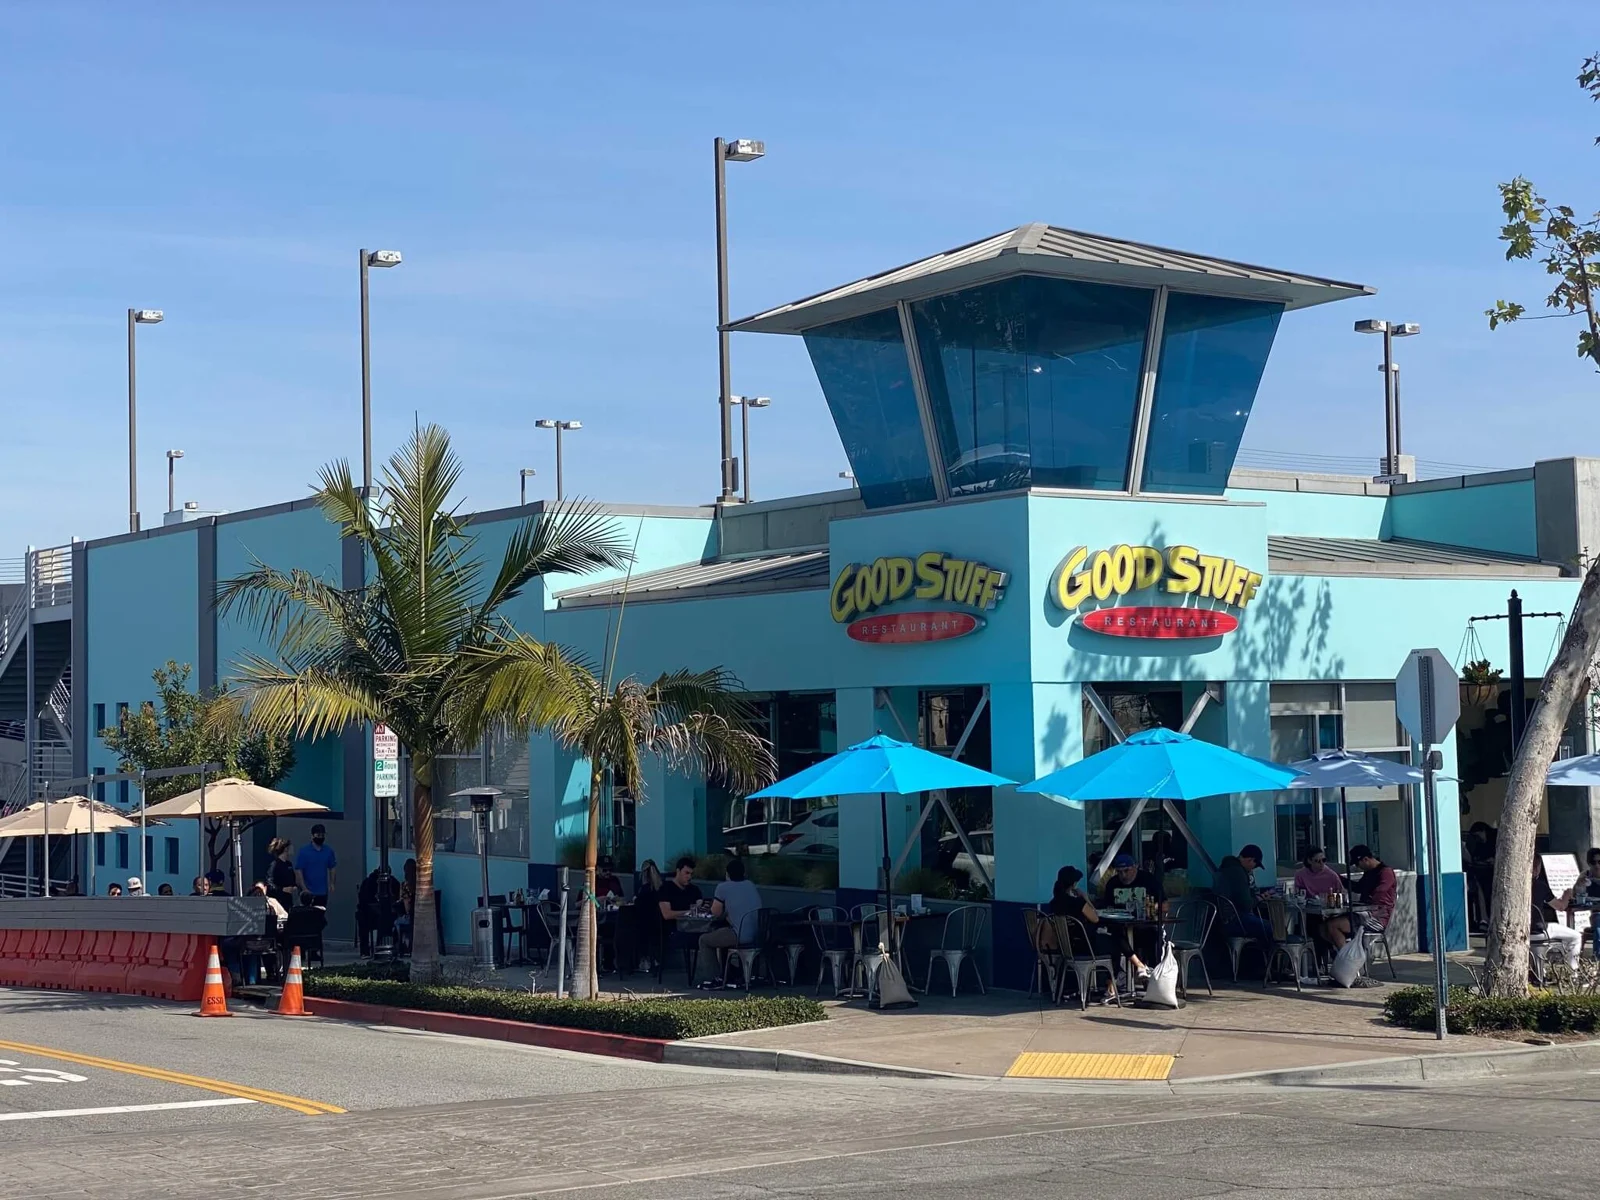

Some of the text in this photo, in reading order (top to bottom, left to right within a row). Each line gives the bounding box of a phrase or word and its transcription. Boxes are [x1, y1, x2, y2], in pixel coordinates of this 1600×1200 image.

[1052, 543, 1263, 610] GOOD STUFF
[830, 551, 1004, 623] GOOD STUFF
[862, 619, 959, 635] RESTAURANT
[1103, 616, 1220, 628] RESTAURANT
[376, 761, 383, 770] 2
